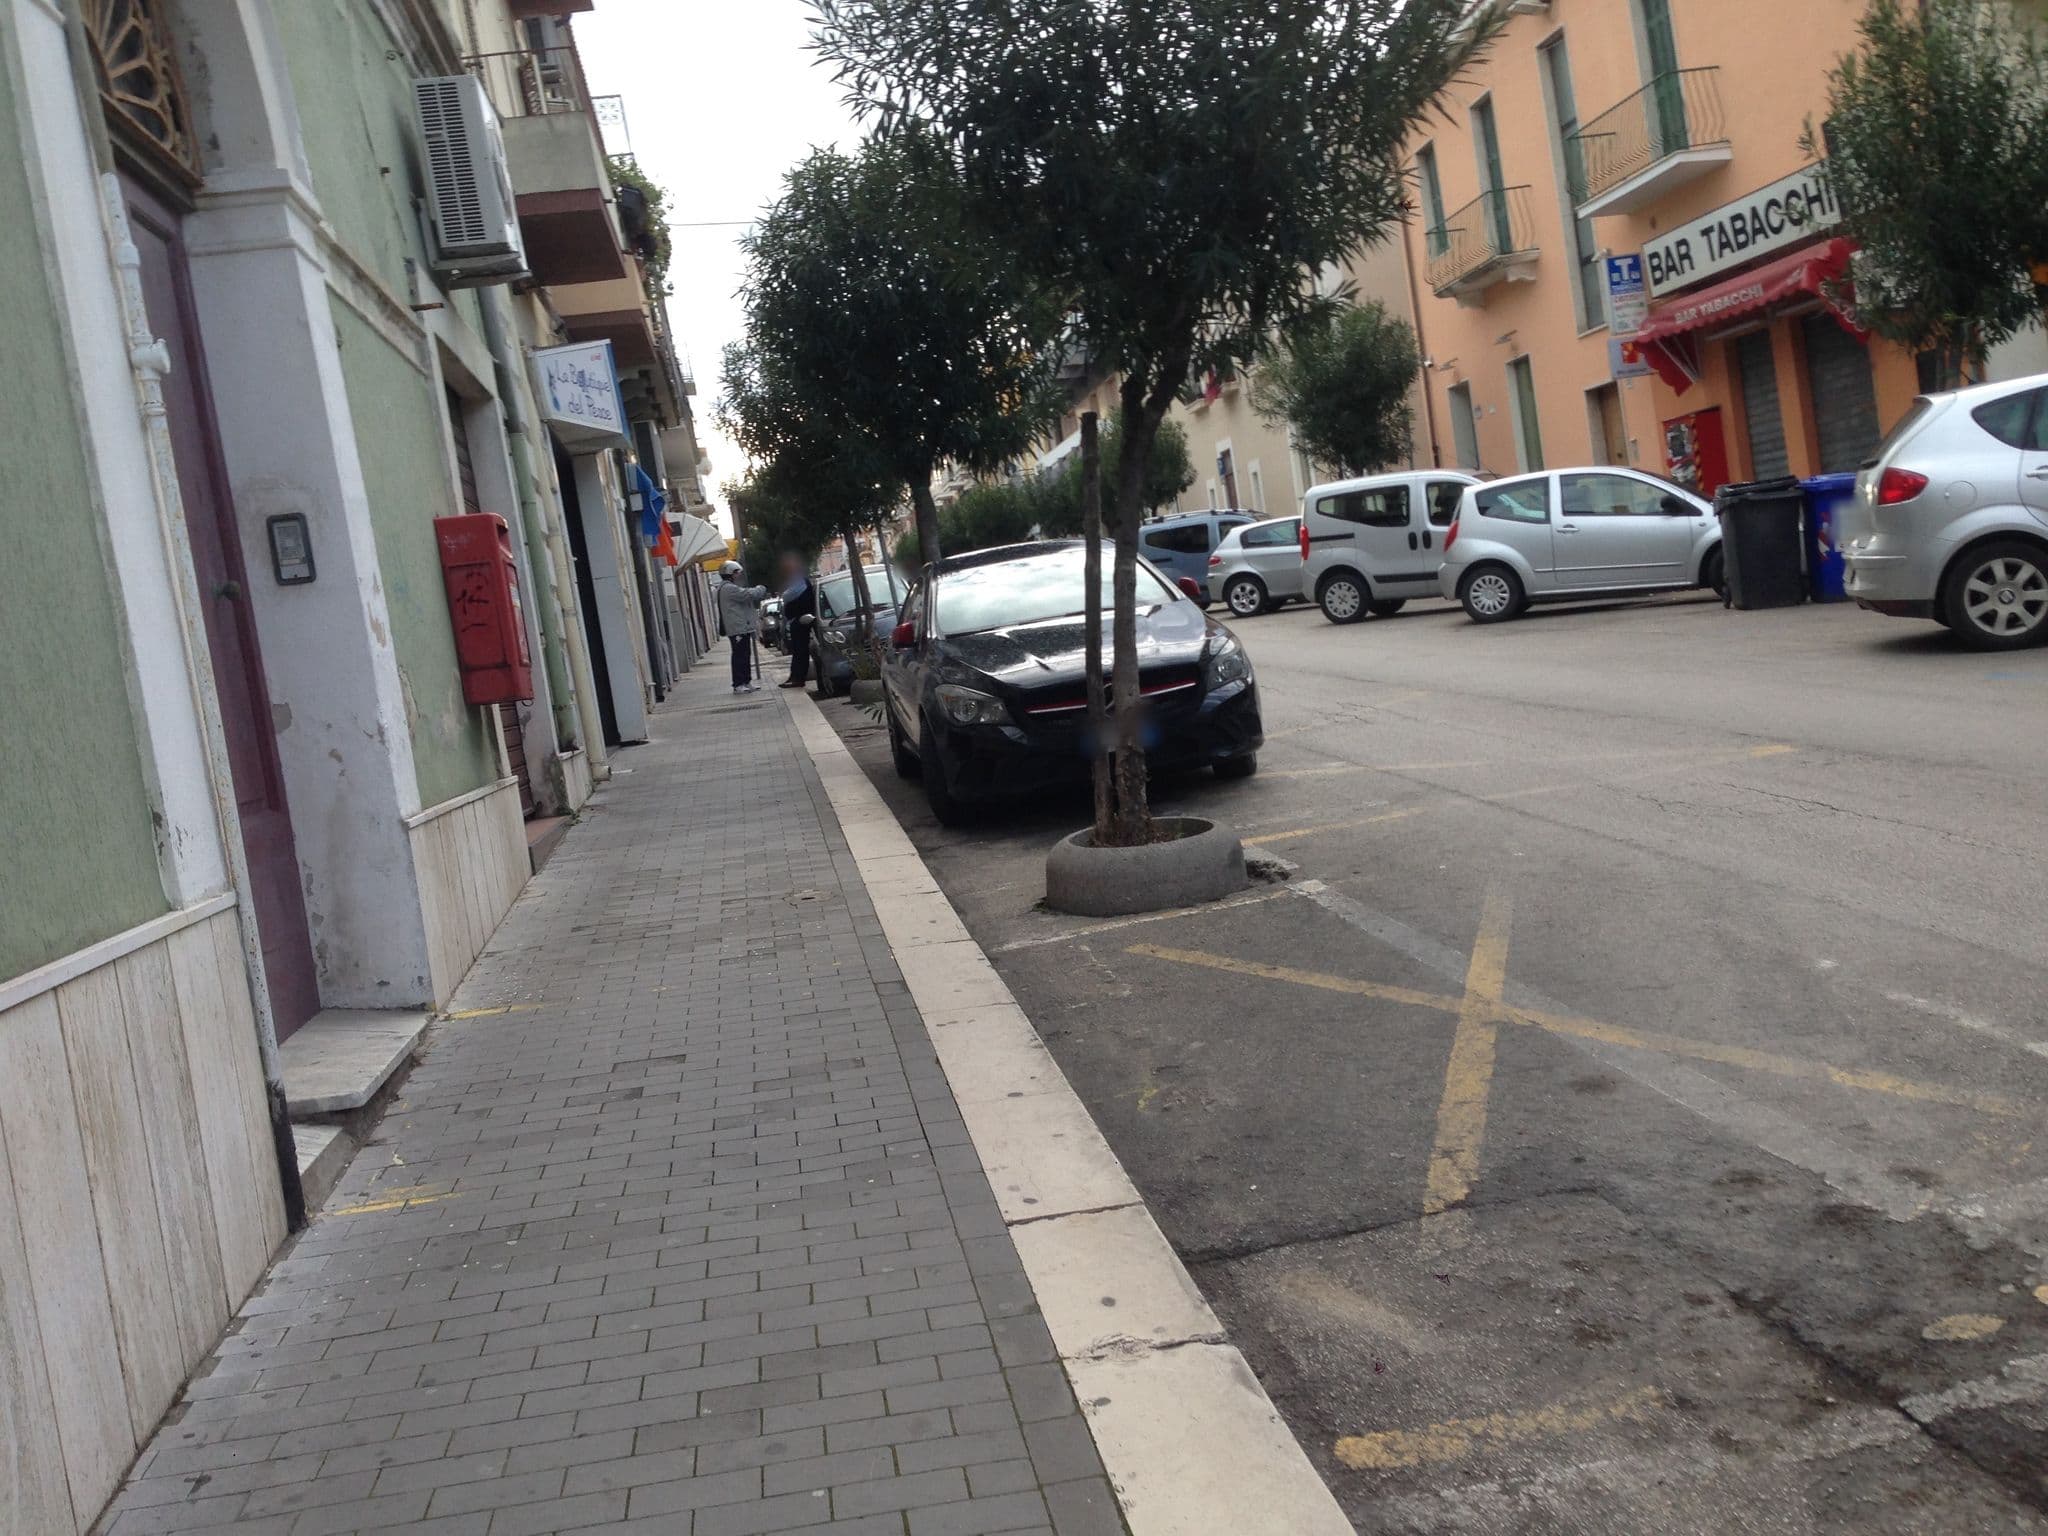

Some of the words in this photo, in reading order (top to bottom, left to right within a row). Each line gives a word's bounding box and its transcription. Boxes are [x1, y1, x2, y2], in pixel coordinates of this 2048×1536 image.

[1648, 238, 1695, 287] BAR
[1701, 176, 1835, 262] TABACCHI
[1675, 308, 1697, 324] BAR
[1700, 284, 1764, 316] TABACCHI
